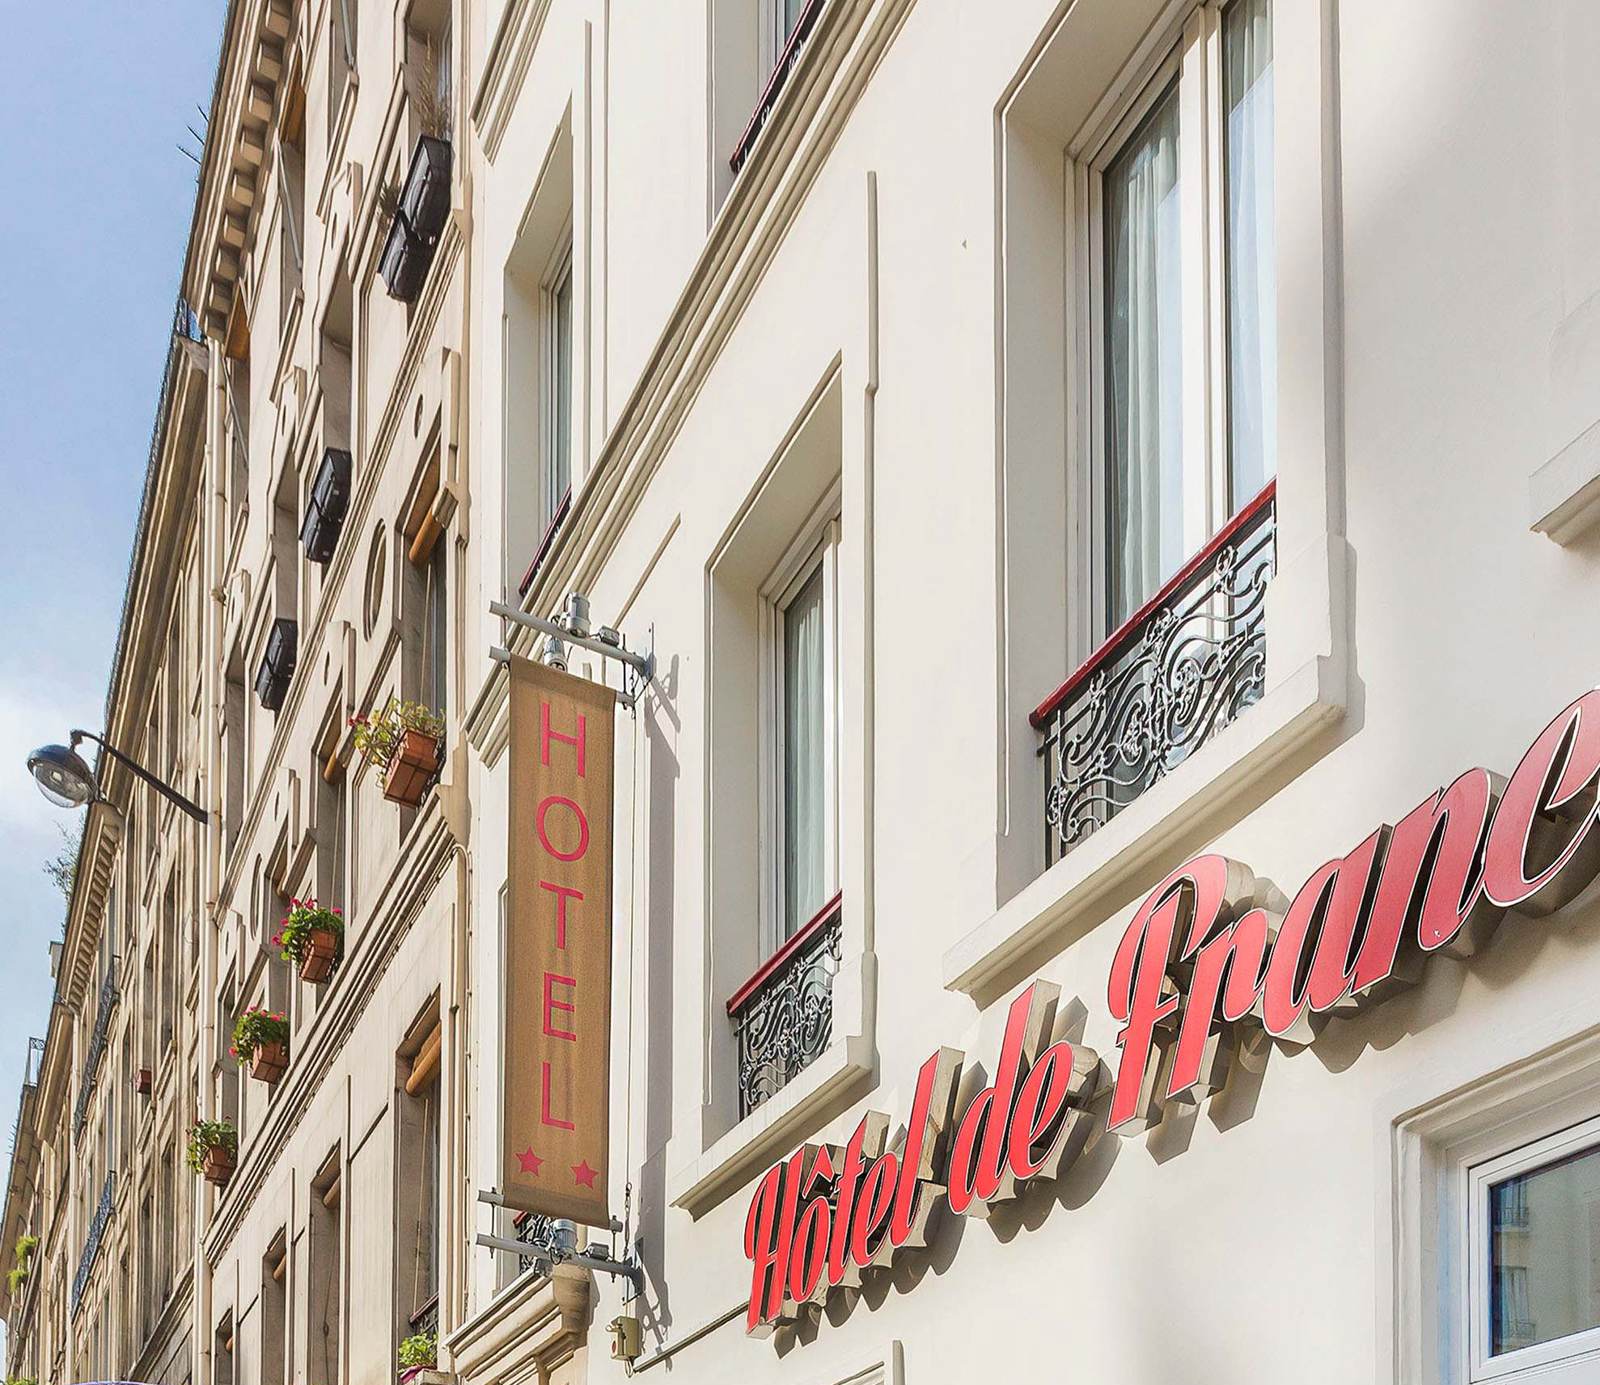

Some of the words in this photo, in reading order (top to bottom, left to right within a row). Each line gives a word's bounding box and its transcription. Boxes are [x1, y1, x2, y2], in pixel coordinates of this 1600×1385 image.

[535, 702, 590, 1133] HOTEL
[743, 1046, 945, 1337] Hôtel
[947, 979, 1080, 1215] de
